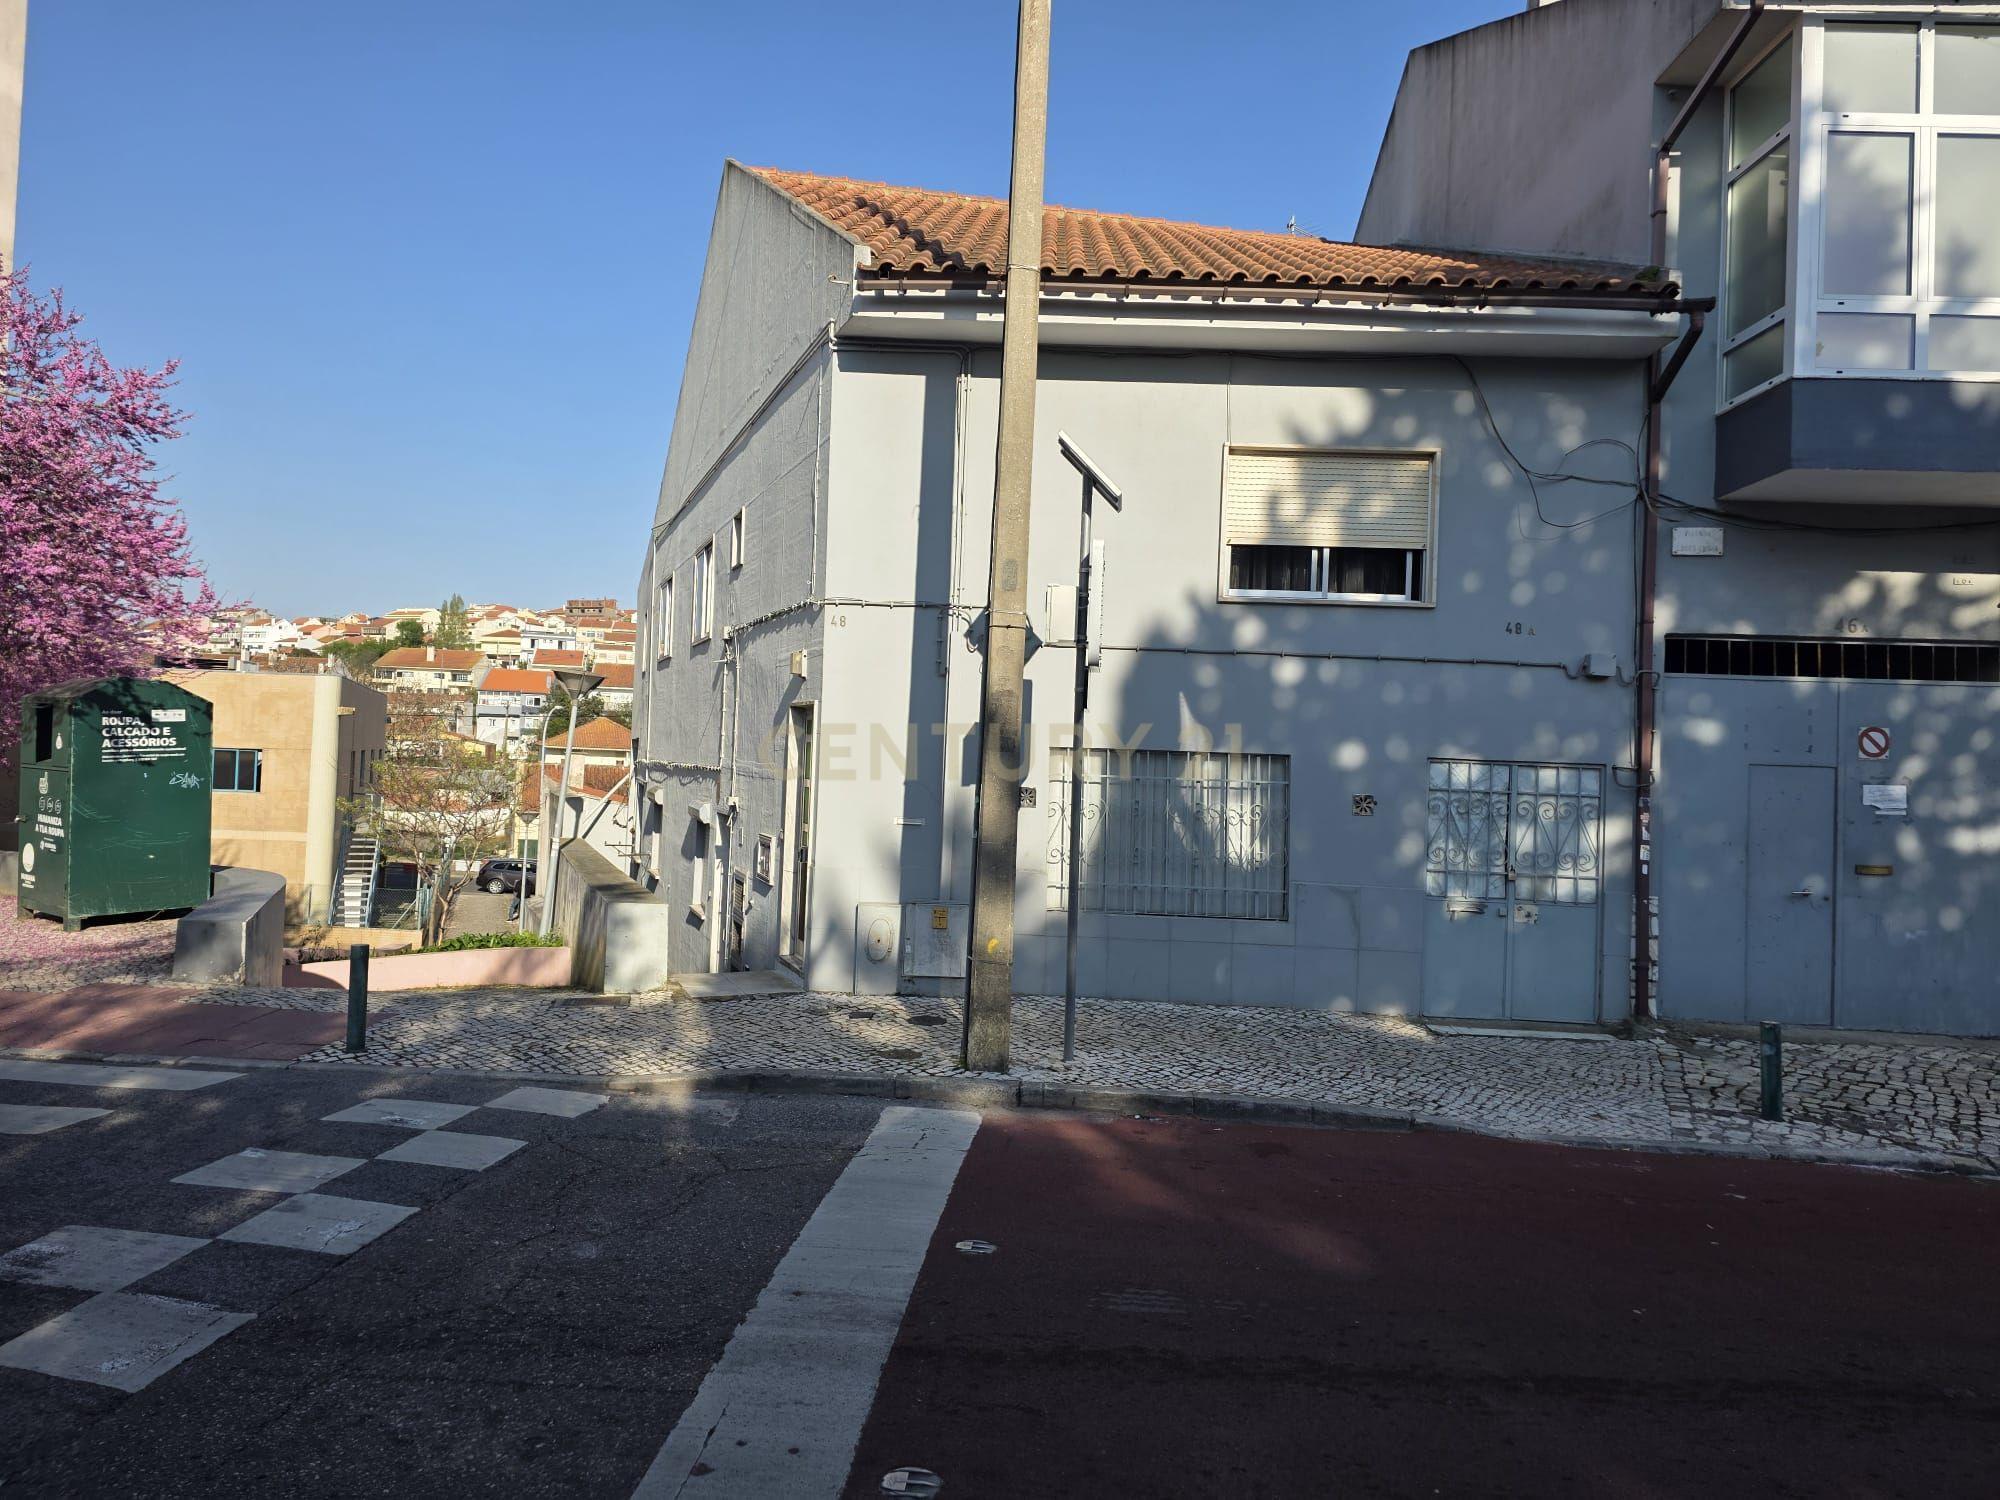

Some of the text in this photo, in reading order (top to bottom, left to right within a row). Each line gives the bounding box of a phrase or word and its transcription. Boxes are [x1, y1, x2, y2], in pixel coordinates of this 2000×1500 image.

[830, 615, 847, 628] 48
[101, 716, 145, 727] ROUPA,
[162, 726, 172, 736] E
[101, 736, 177, 748] ACESSÓRIOS
